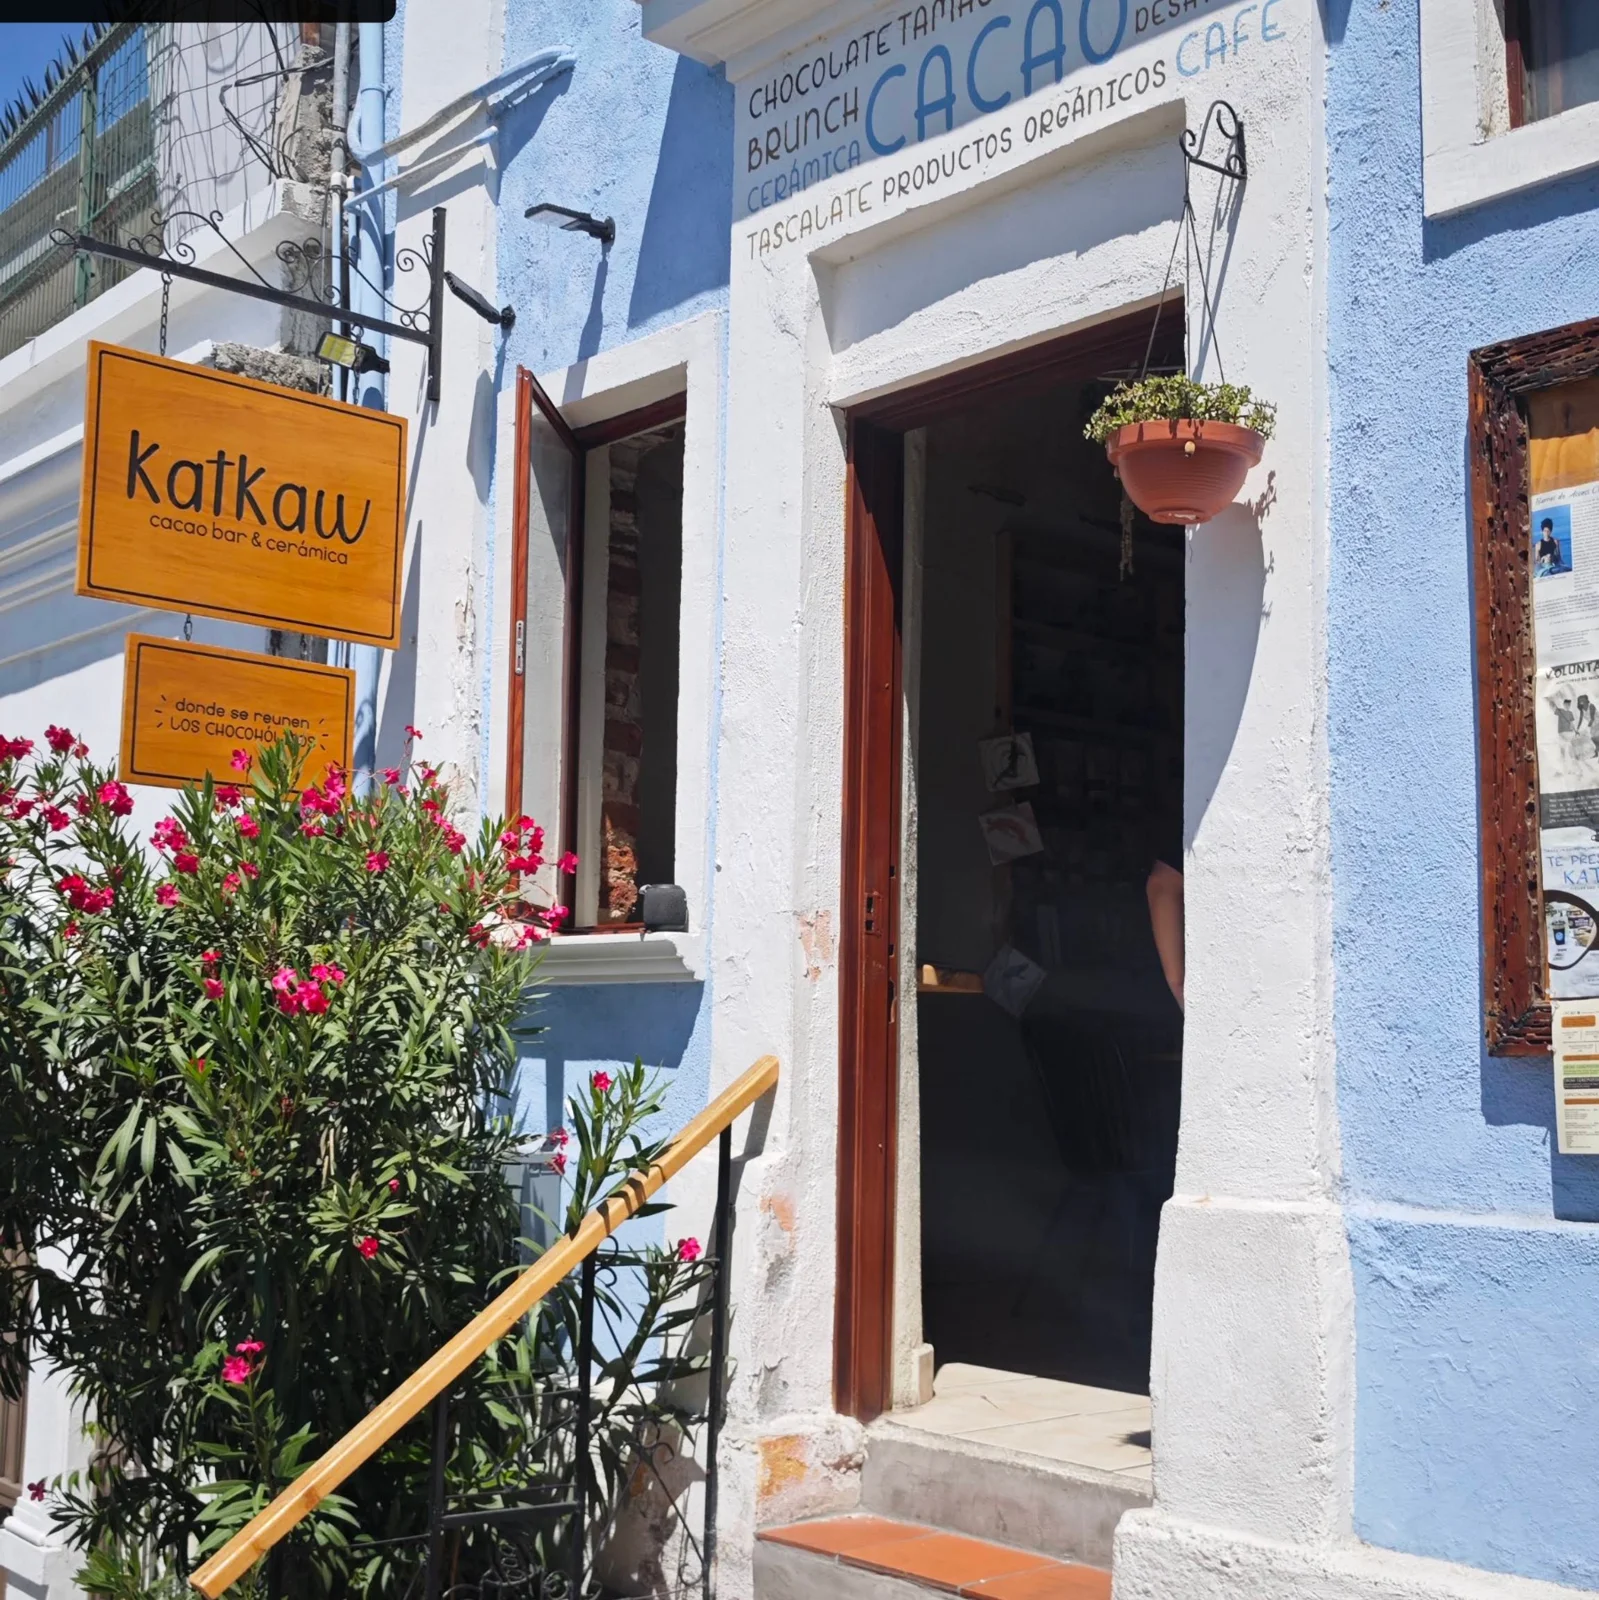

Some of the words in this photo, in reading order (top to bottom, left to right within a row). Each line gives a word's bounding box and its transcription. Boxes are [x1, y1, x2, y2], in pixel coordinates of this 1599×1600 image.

[1135, 0, 1209, 34] DES
[749, 21, 892, 119] CHOCOLATE
[898, 0, 992, 46] TAMA
[865, 0, 1128, 156] CACAO
[746, 181, 873, 260] TASCALATE
[882, 127, 1012, 203] PRODUCTOS
[1024, 60, 1166, 143] ORGÁNICOS
[747, 87, 859, 173] BRUNCH
[747, 139, 861, 214] CERÁMICA
[149, 514, 208, 537] cacao
[212, 522, 247, 544] bar
[251, 531, 262, 548] &
[266, 538, 348, 565] cerámica
[170, 717, 200, 733] LOS
[175, 698, 225, 717] donde
[230, 708, 249, 721] se
[254, 712, 310, 730] reunen
